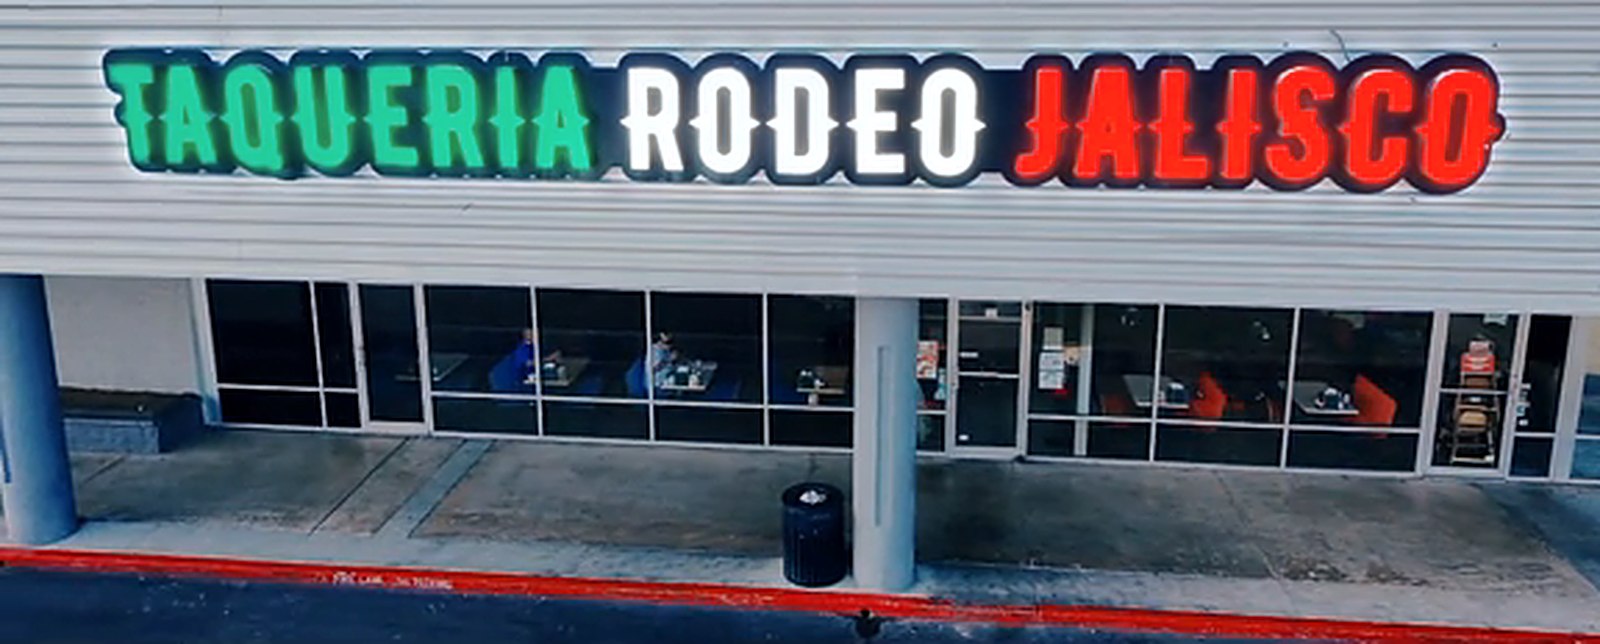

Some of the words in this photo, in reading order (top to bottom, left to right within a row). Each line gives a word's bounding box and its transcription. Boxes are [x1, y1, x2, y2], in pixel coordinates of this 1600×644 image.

[107, 63, 591, 172] TAQUERIA
[620, 67, 986, 175] RODEO
[1014, 65, 1499, 185] JALISCO
